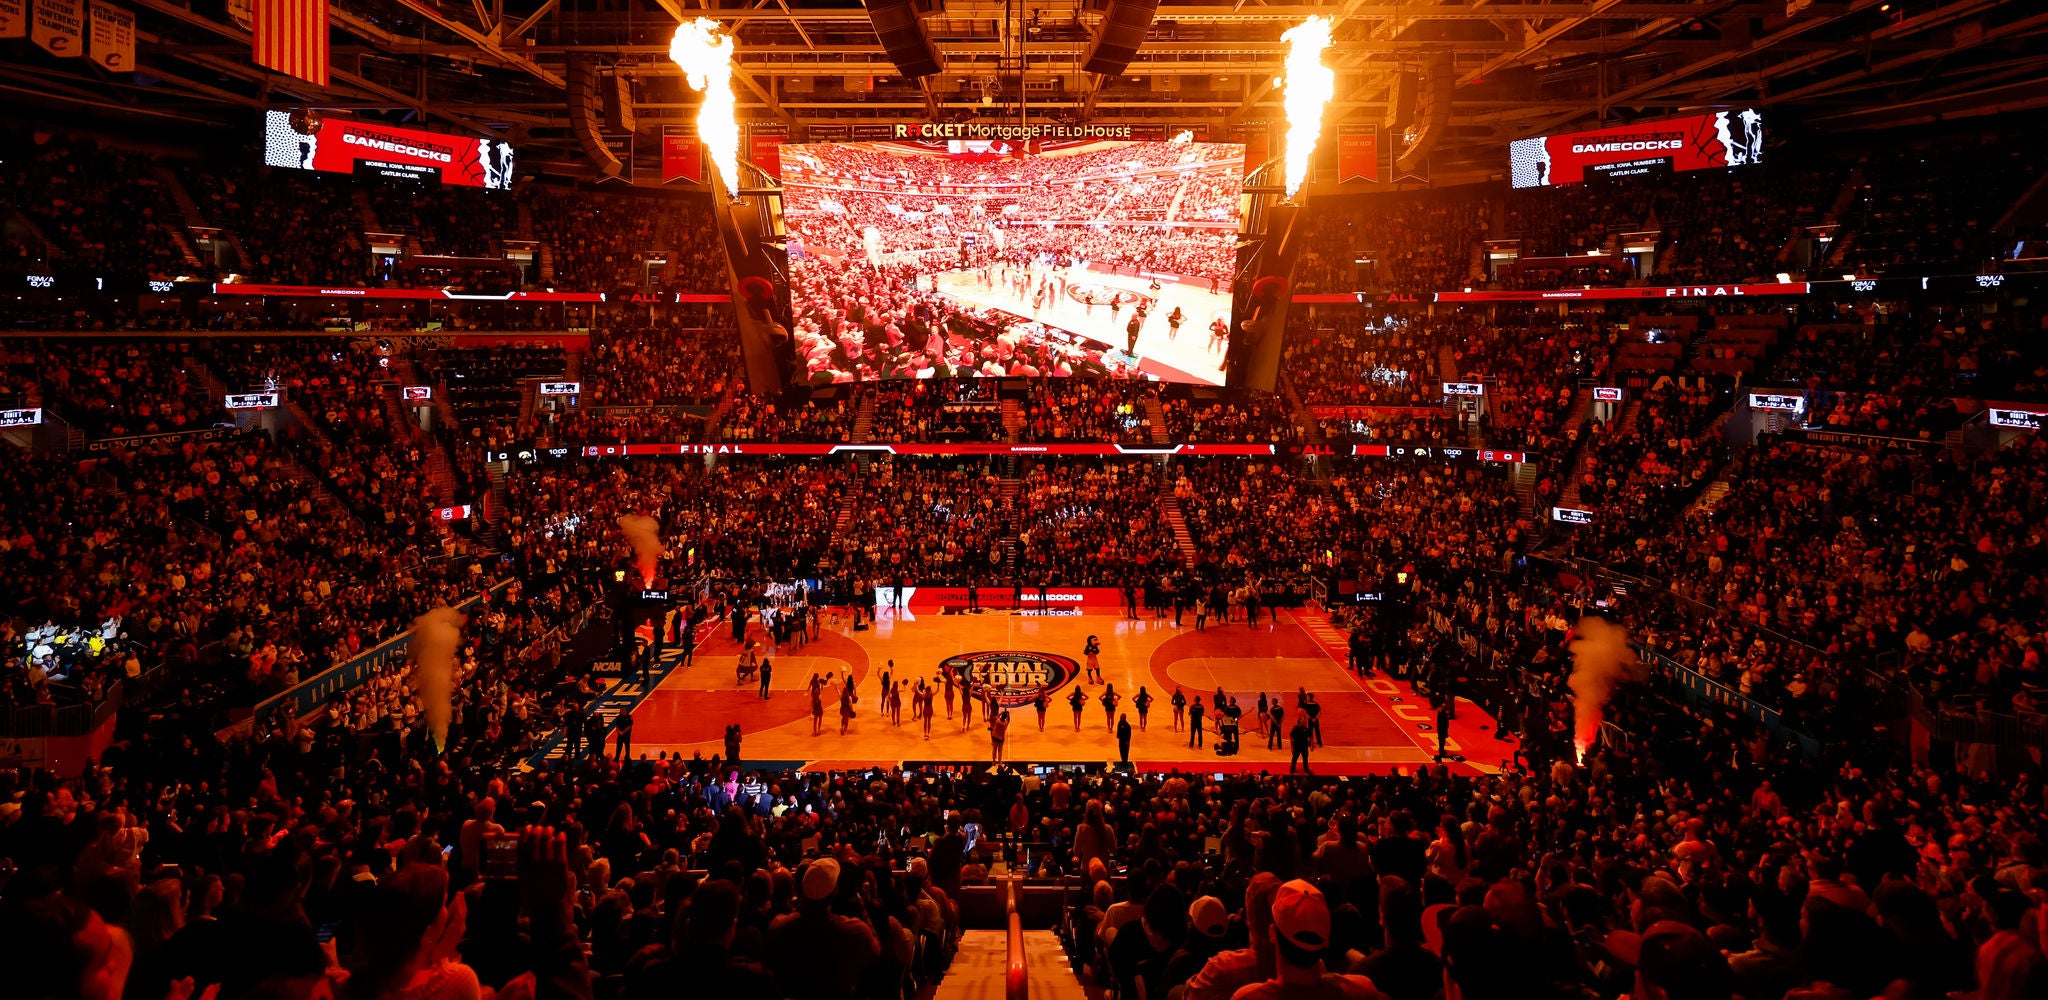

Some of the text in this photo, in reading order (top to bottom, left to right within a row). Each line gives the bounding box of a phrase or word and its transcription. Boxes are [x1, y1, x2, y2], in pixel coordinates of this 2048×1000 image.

[897, 123, 1132, 140] ROCKET Mortgage FIELDHOUSE
[345, 126, 452, 153] SOUTH CAROLINA
[1573, 132, 1683, 145] SOUTH CAROLINA
[343, 133, 452, 163] GAMECOCKS
[1572, 139, 1683, 154] GAMECOCKS
[1633, 159, 1656, 167] NUMBER
[381, 170, 402, 178] CAITLIN
[630, 293, 662, 303] ALL
[1387, 293, 1418, 303] ALL
[548, 447, 568, 455] 10:00
[1301, 445, 1335, 455] ALL
[591, 661, 622, 672] NCAA
[971, 661, 1048, 673] FINAL
[971, 672, 1049, 686] FOUR
